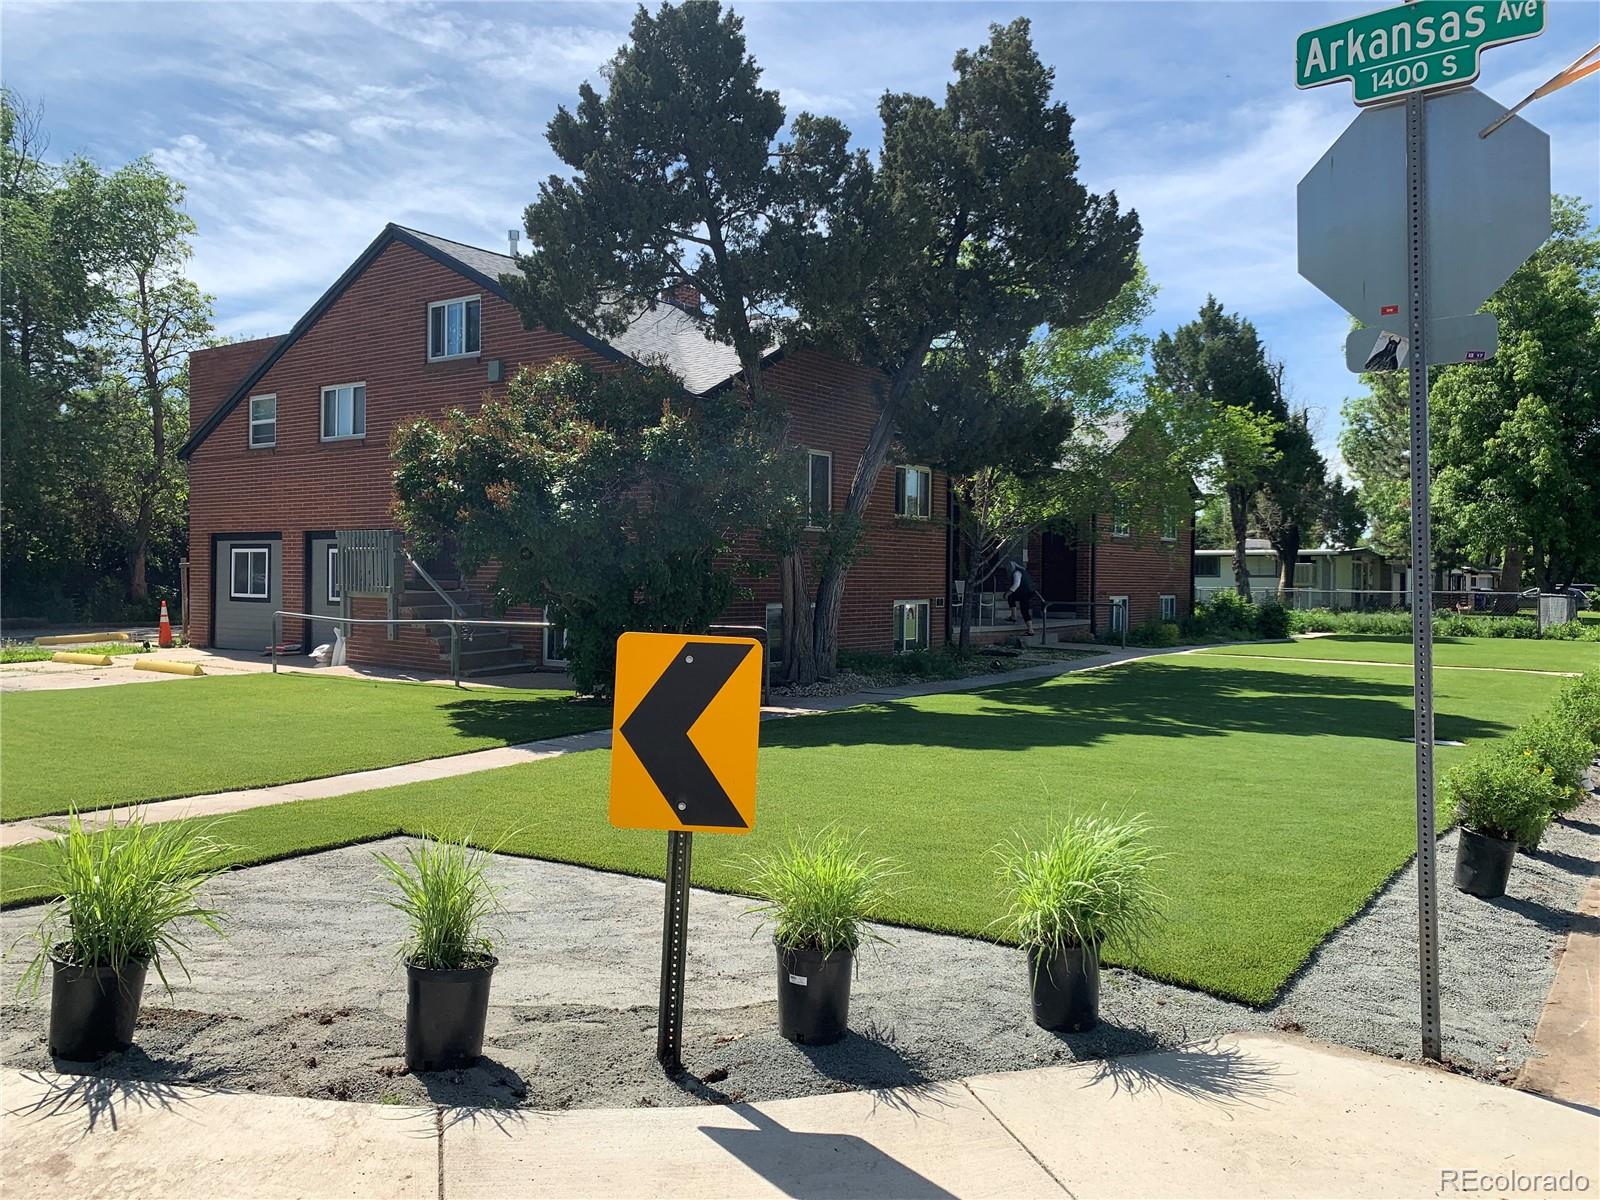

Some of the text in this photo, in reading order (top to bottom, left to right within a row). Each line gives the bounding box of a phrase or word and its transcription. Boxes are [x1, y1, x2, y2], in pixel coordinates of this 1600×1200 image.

[1303, 0, 1538, 77] Arkansas Ave
[1371, 55, 1458, 92] 1400 S
